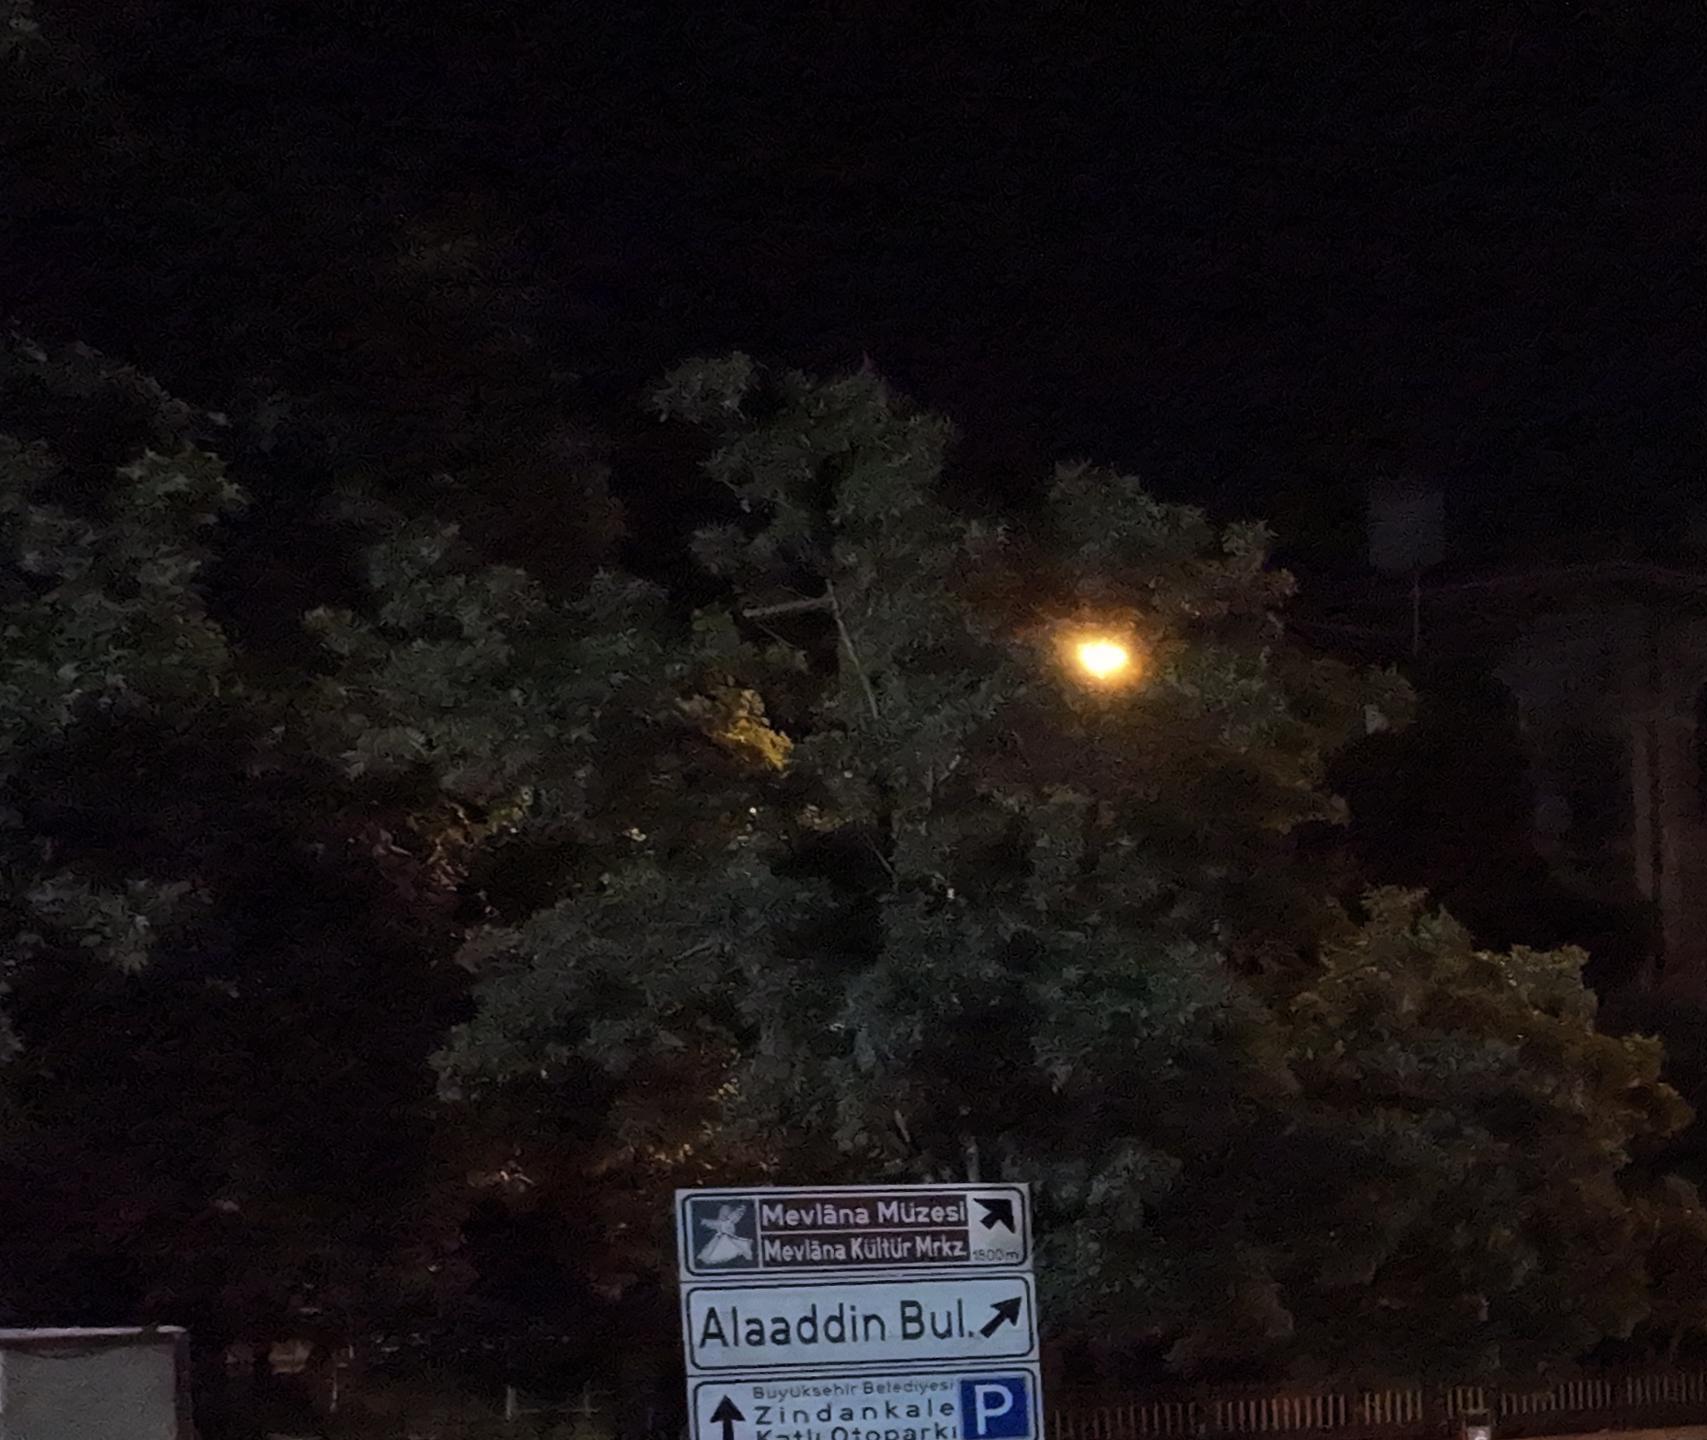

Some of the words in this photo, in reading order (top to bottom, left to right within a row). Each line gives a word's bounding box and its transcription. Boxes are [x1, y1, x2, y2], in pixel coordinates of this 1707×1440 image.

[762, 1202, 870, 1226] Mevlâna
[877, 1200, 965, 1223] Müzesi
[764, 1239, 846, 1262] Mevlâna
[850, 1236, 912, 1260] Kültür
[915, 1234, 967, 1257] Mrkz
[699, 1302, 886, 1349] Alaaddin
[900, 1298, 973, 1340] Bul.
[755, 1399, 955, 1426] Zindankale
[974, 1383, 1014, 1435] P
